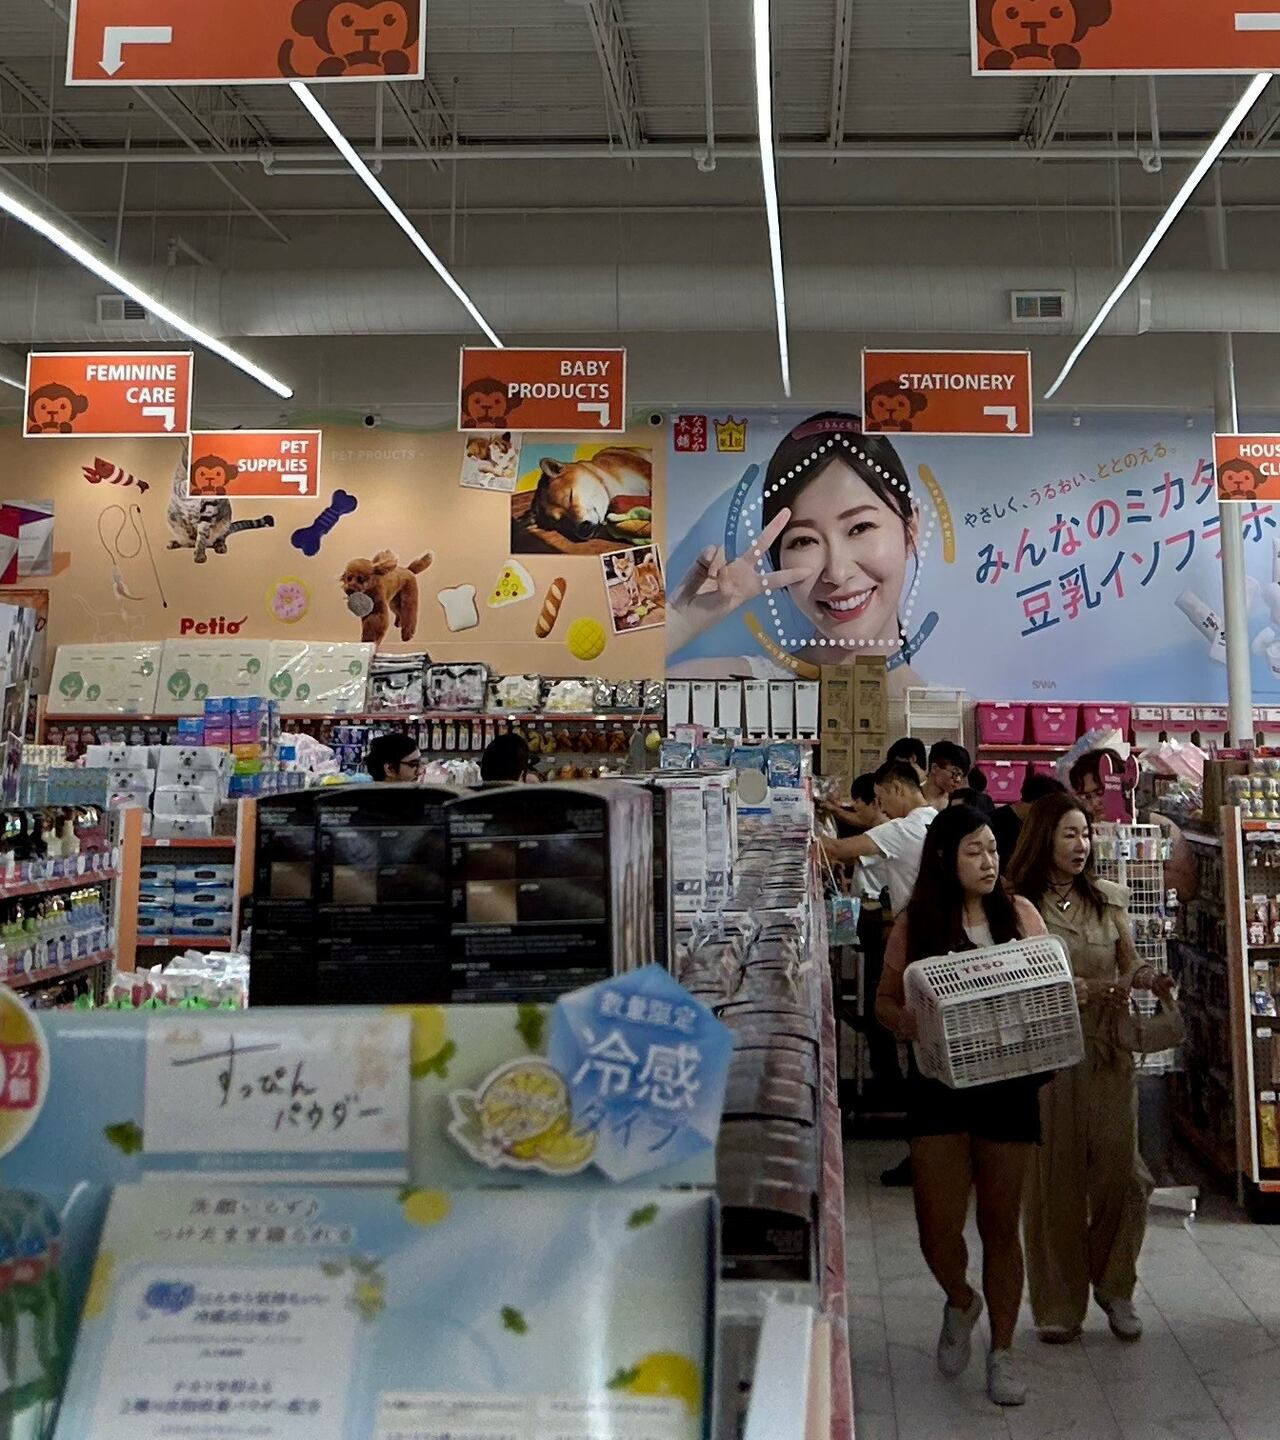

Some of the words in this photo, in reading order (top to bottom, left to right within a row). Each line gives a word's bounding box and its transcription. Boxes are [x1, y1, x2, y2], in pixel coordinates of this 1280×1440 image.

[86, 364, 176, 382] FEMININE
[561, 360, 610, 376] BABY
[508, 383, 609, 399] PRODUCTS
[899, 372, 1015, 392] STATIONERY
[126, 387, 175, 404] CARE
[281, 440, 309, 455] PET
[238, 458, 308, 474] SUPPLIES
[180, 615, 248, 635] Petio
[172, 1033, 319, 1107] すっぴん
[573, 1027, 702, 1108] 冷感
[274, 1095, 384, 1130] パウダー
[573, 1096, 689, 1152] タイプ
